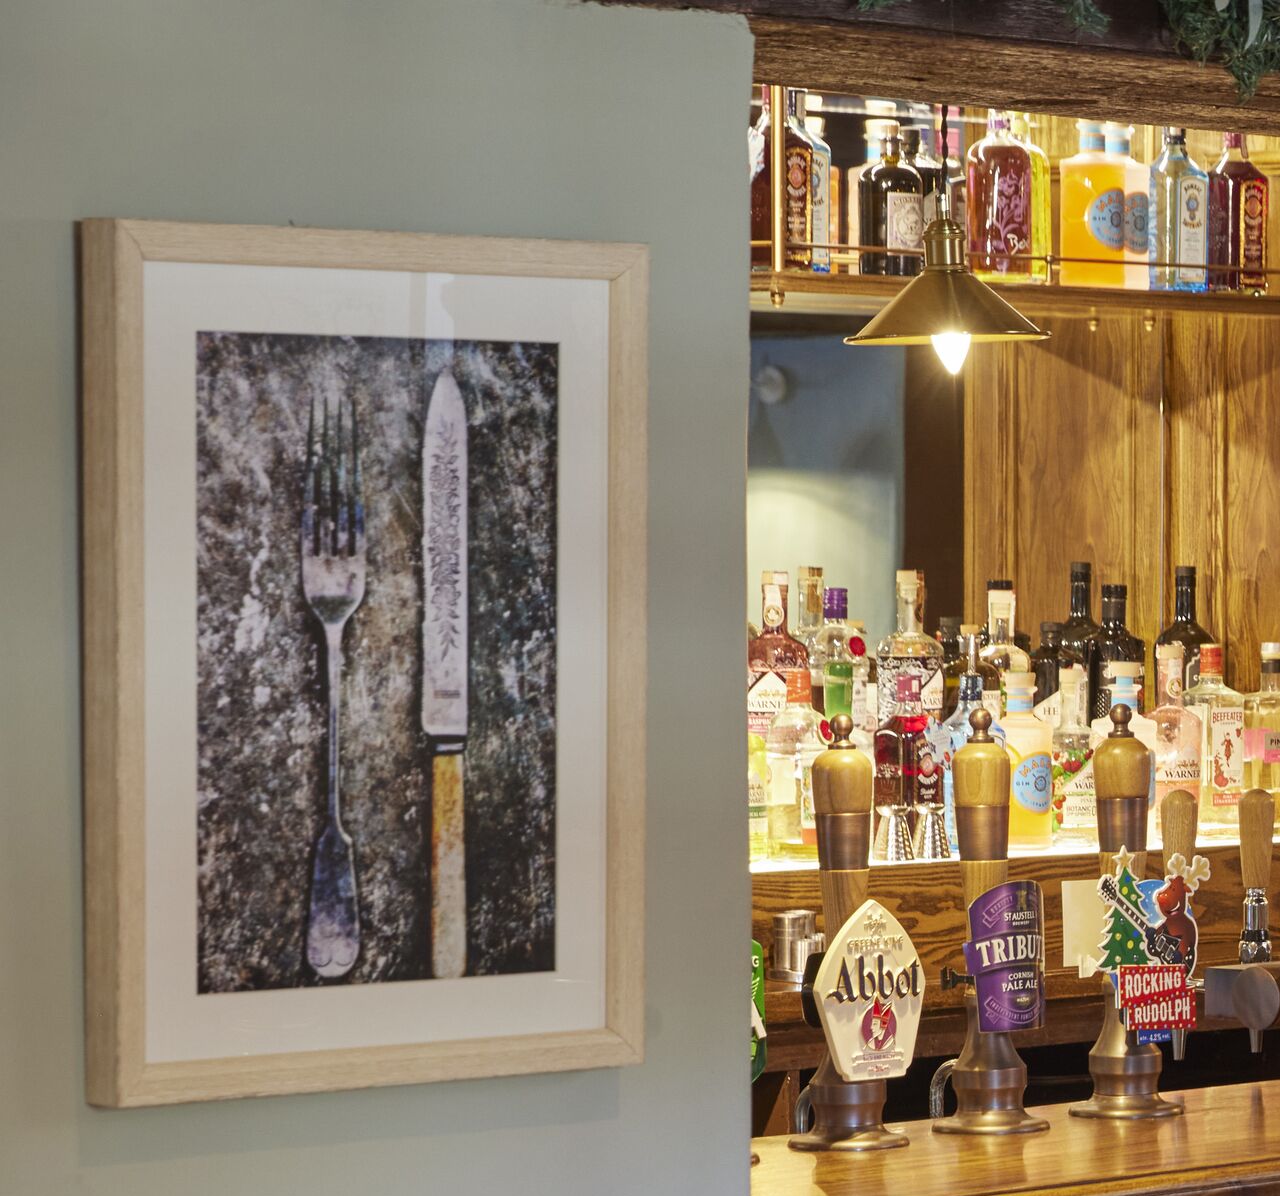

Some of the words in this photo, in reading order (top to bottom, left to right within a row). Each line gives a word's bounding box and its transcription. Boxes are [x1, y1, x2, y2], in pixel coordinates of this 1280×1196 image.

[1212, 711, 1243, 724] BEEFEATER
[1011, 910, 1036, 921] AUSTELL
[847, 937, 882, 951] GREENE
[883, 935, 904, 949] KING
[825, 953, 920, 1004] Abbot
[1008, 971, 1034, 981] CORNISH
[1002, 983, 1024, 993] PALE
[1025, 980, 1038, 989] ALE
[1125, 971, 1182, 999] ROCKING
[1134, 996, 1191, 1024] RUDOLPH
